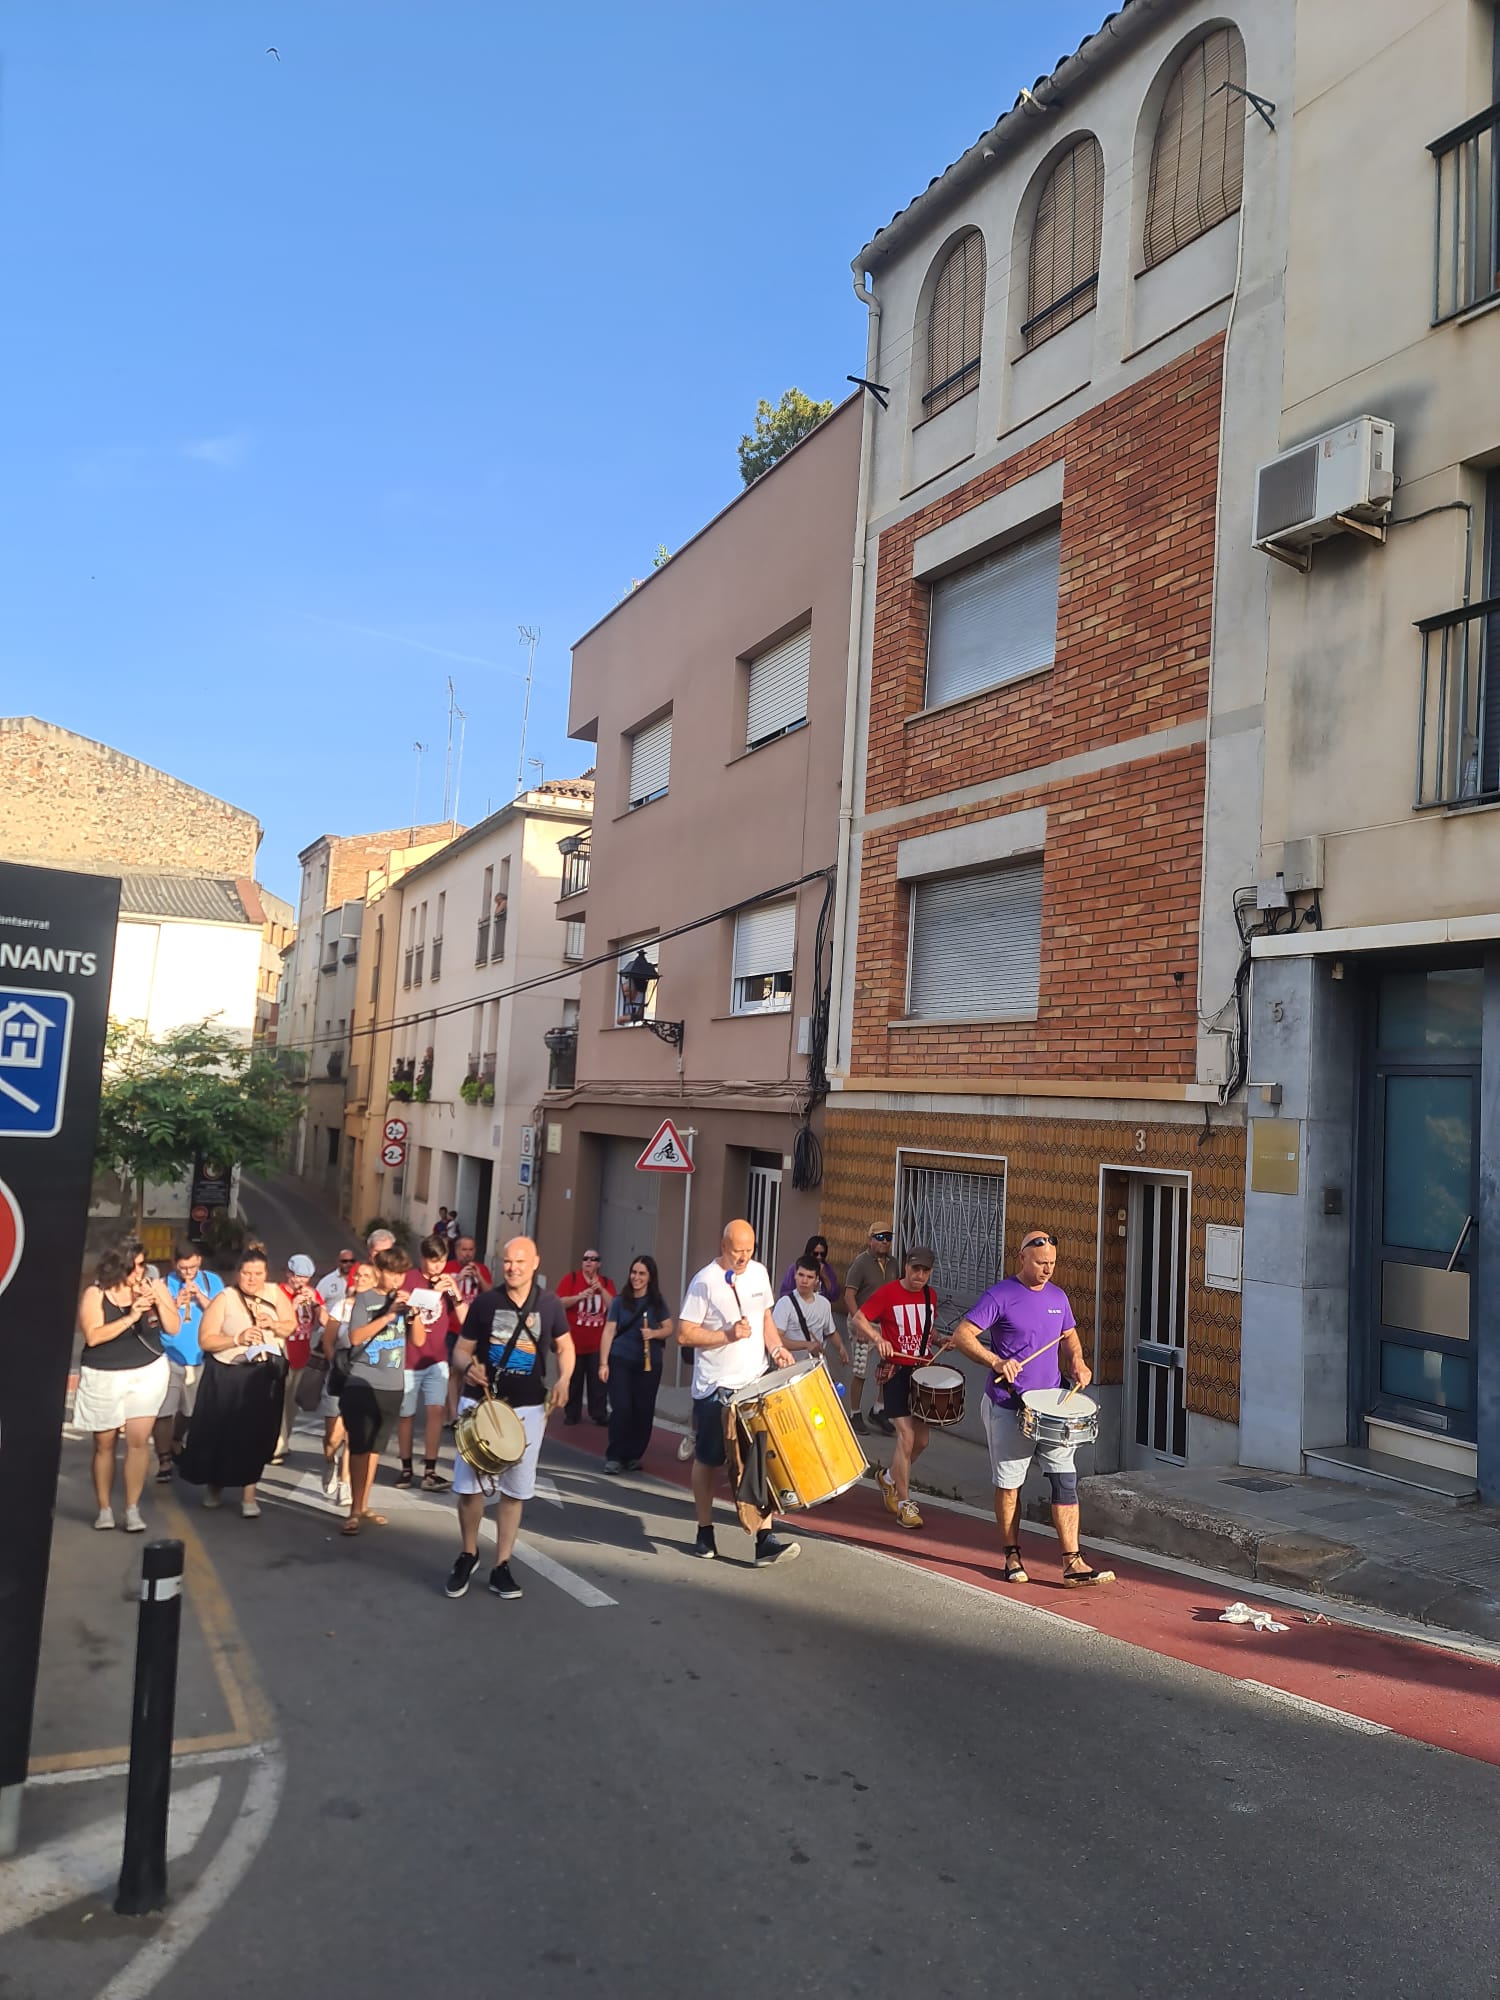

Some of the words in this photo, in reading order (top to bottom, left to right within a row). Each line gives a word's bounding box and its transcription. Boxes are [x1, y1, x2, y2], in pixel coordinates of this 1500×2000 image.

[0, 942, 97, 976] NANTS
[1271, 1001, 1283, 1022] 5
[1136, 1130, 1146, 1152] 3
